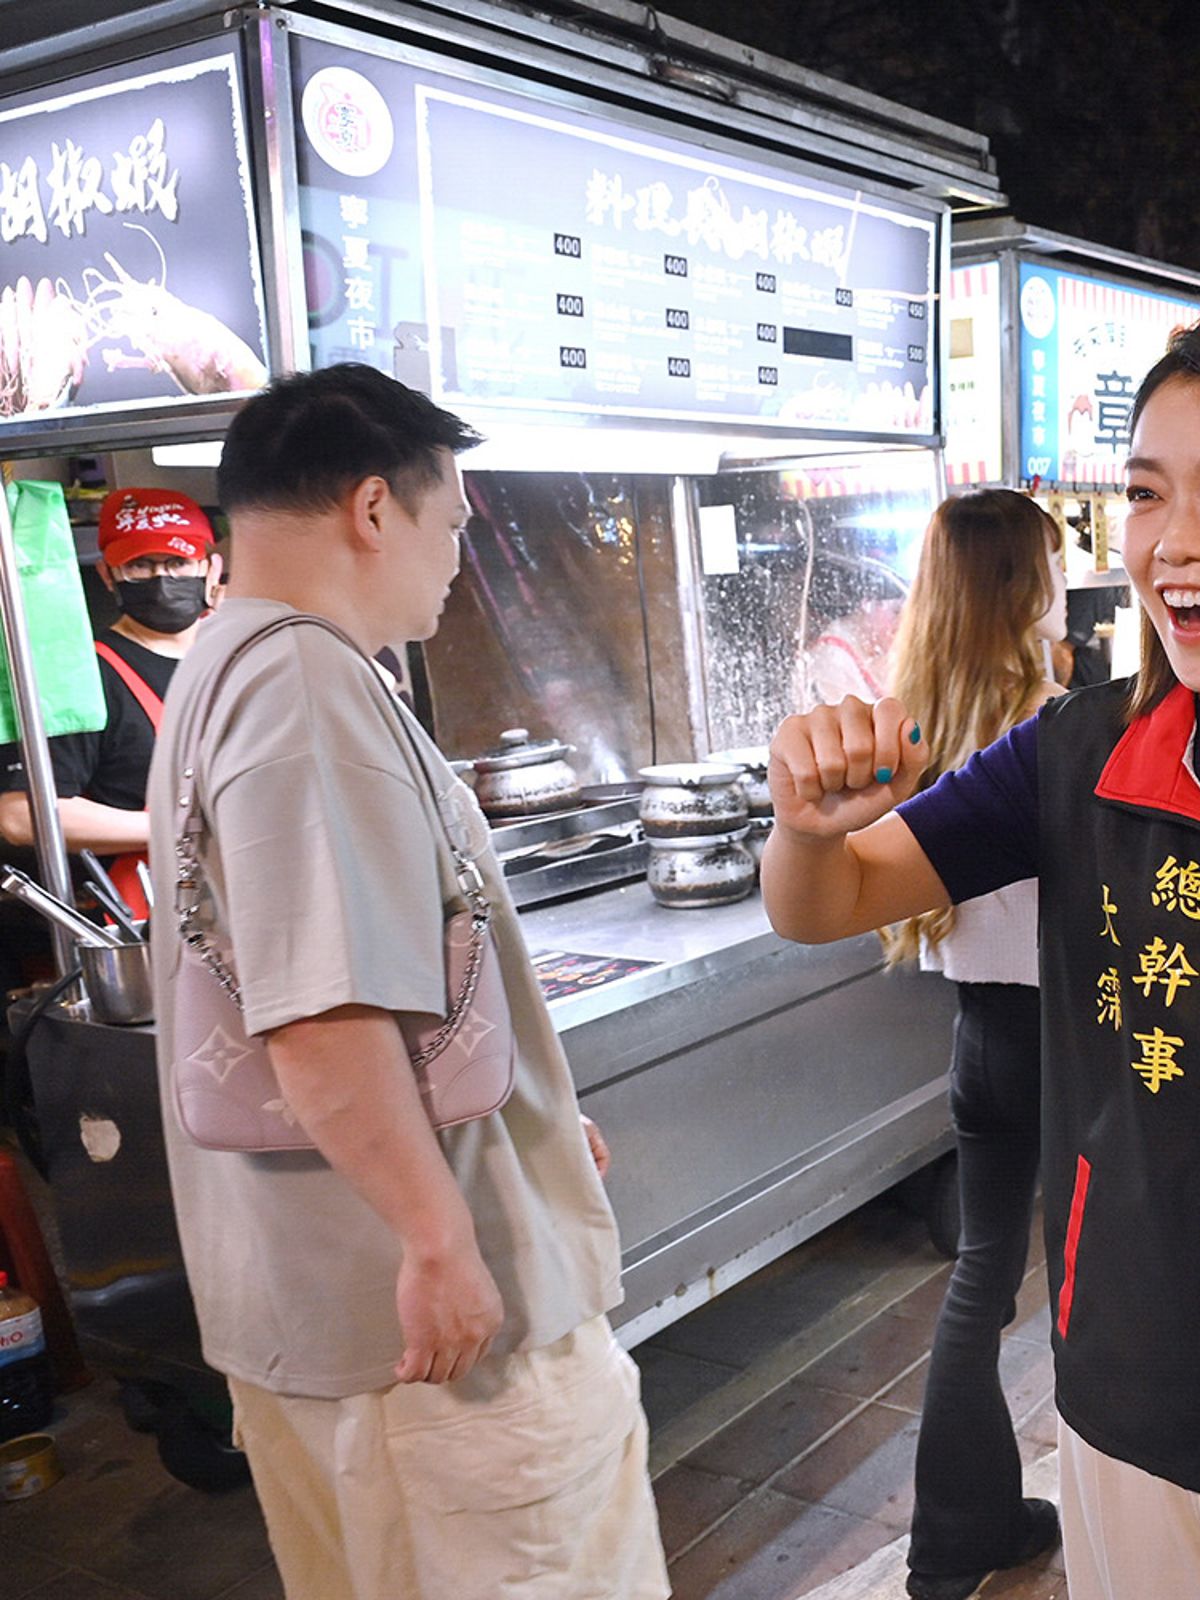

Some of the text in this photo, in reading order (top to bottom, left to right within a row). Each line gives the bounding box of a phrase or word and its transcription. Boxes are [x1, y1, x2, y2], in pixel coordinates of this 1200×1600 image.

[555, 236, 580, 256] 400
[666, 256, 687, 275] 400
[757, 275, 775, 292] 400
[558, 295, 582, 315] 400
[667, 310, 689, 328] 400
[757, 325, 776, 341] 400
[561, 348, 585, 367] 400
[668, 359, 690, 376] 400
[759, 368, 777, 384] 400
[1027, 456, 1051, 477] 007
